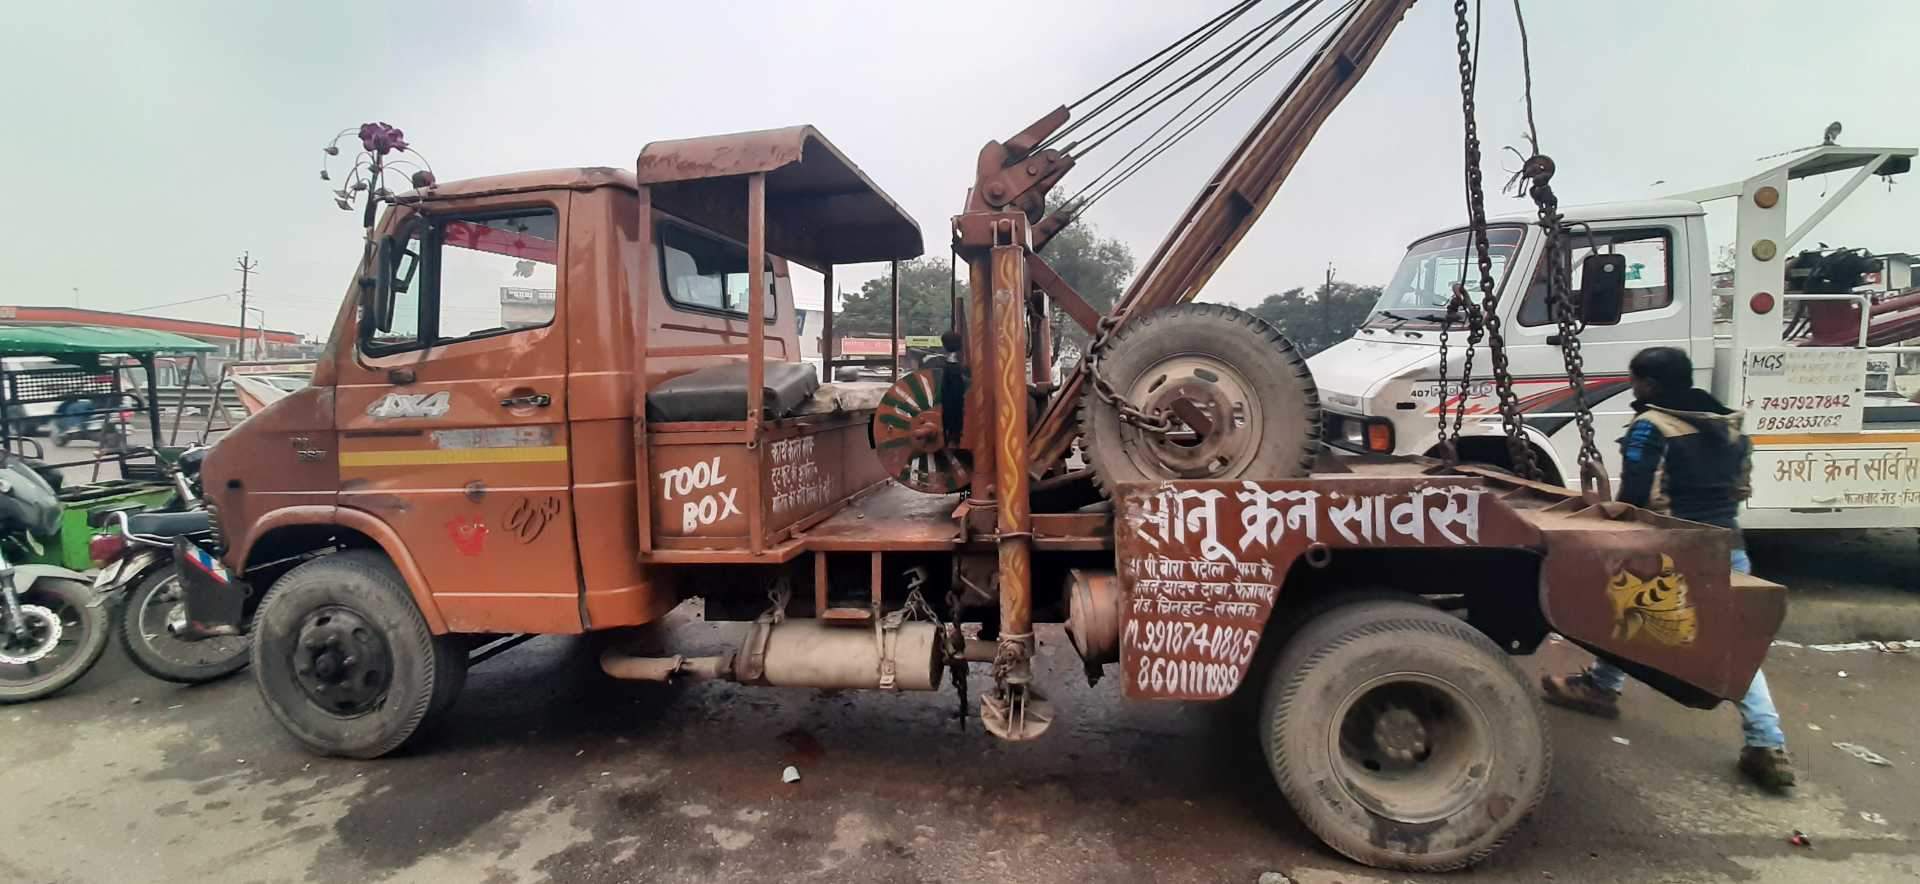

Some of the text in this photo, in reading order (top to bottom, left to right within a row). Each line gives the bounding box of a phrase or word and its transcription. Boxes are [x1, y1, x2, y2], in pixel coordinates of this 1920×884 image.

[1752, 354, 1784, 370] MGS
[1411, 390, 1429, 398] 407
[659, 456, 728, 500] TOOL
[1824, 453, 1861, 482] क्रेन
[683, 487, 743, 533] BOX
[1236, 481, 1320, 552] क्रेन
